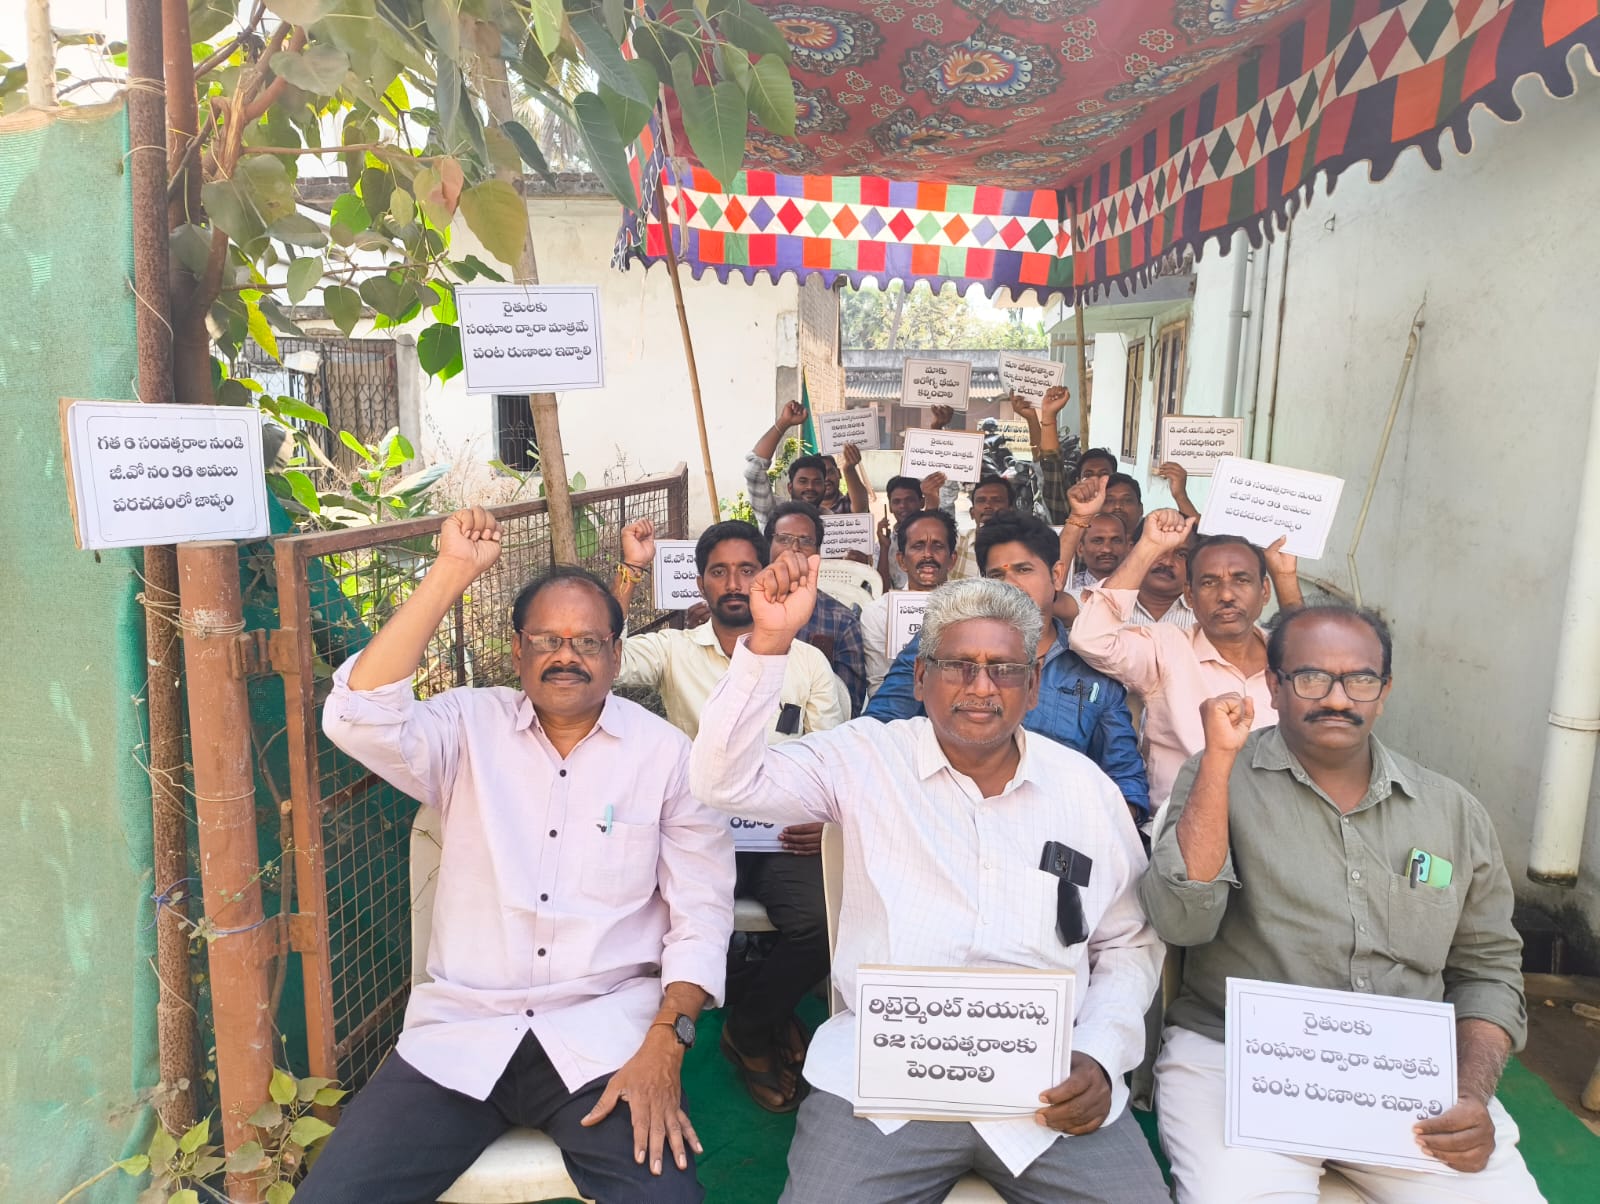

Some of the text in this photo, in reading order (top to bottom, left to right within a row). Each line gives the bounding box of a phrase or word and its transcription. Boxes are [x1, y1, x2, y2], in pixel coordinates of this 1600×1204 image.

[502, 301, 547, 317] రైతులకు
[466, 320, 589, 337] సంఘాల ద్వారా మాత్రమే
[507, 347, 552, 357] రుణాలు
[555, 345, 591, 360] ఇవ్వాలి
[97, 436, 244, 453] గత 6 సంవత్సరాల నుండి
[147, 465, 169, 479] నం
[172, 465, 193, 478] 36
[195, 464, 238, 477] అమలు
[113, 492, 234, 512] పరచడంలో జాప్యం
[1266, 501, 1280, 509] 36
[868, 996, 1049, 1026] రిటైర్మెంట్ వయస్సు
[1303, 1011, 1373, 1036] రైతులకు
[873, 1033, 1038, 1057] 62 సంవత్సరాలకు
[1246, 1038, 1440, 1080] సంఘాల ద్వారా మాత్రమే
[906, 1060, 995, 1083] పెంచాలి
[1252, 1076, 1444, 1121] పంట రుణాలు ఇవ్వాలి
